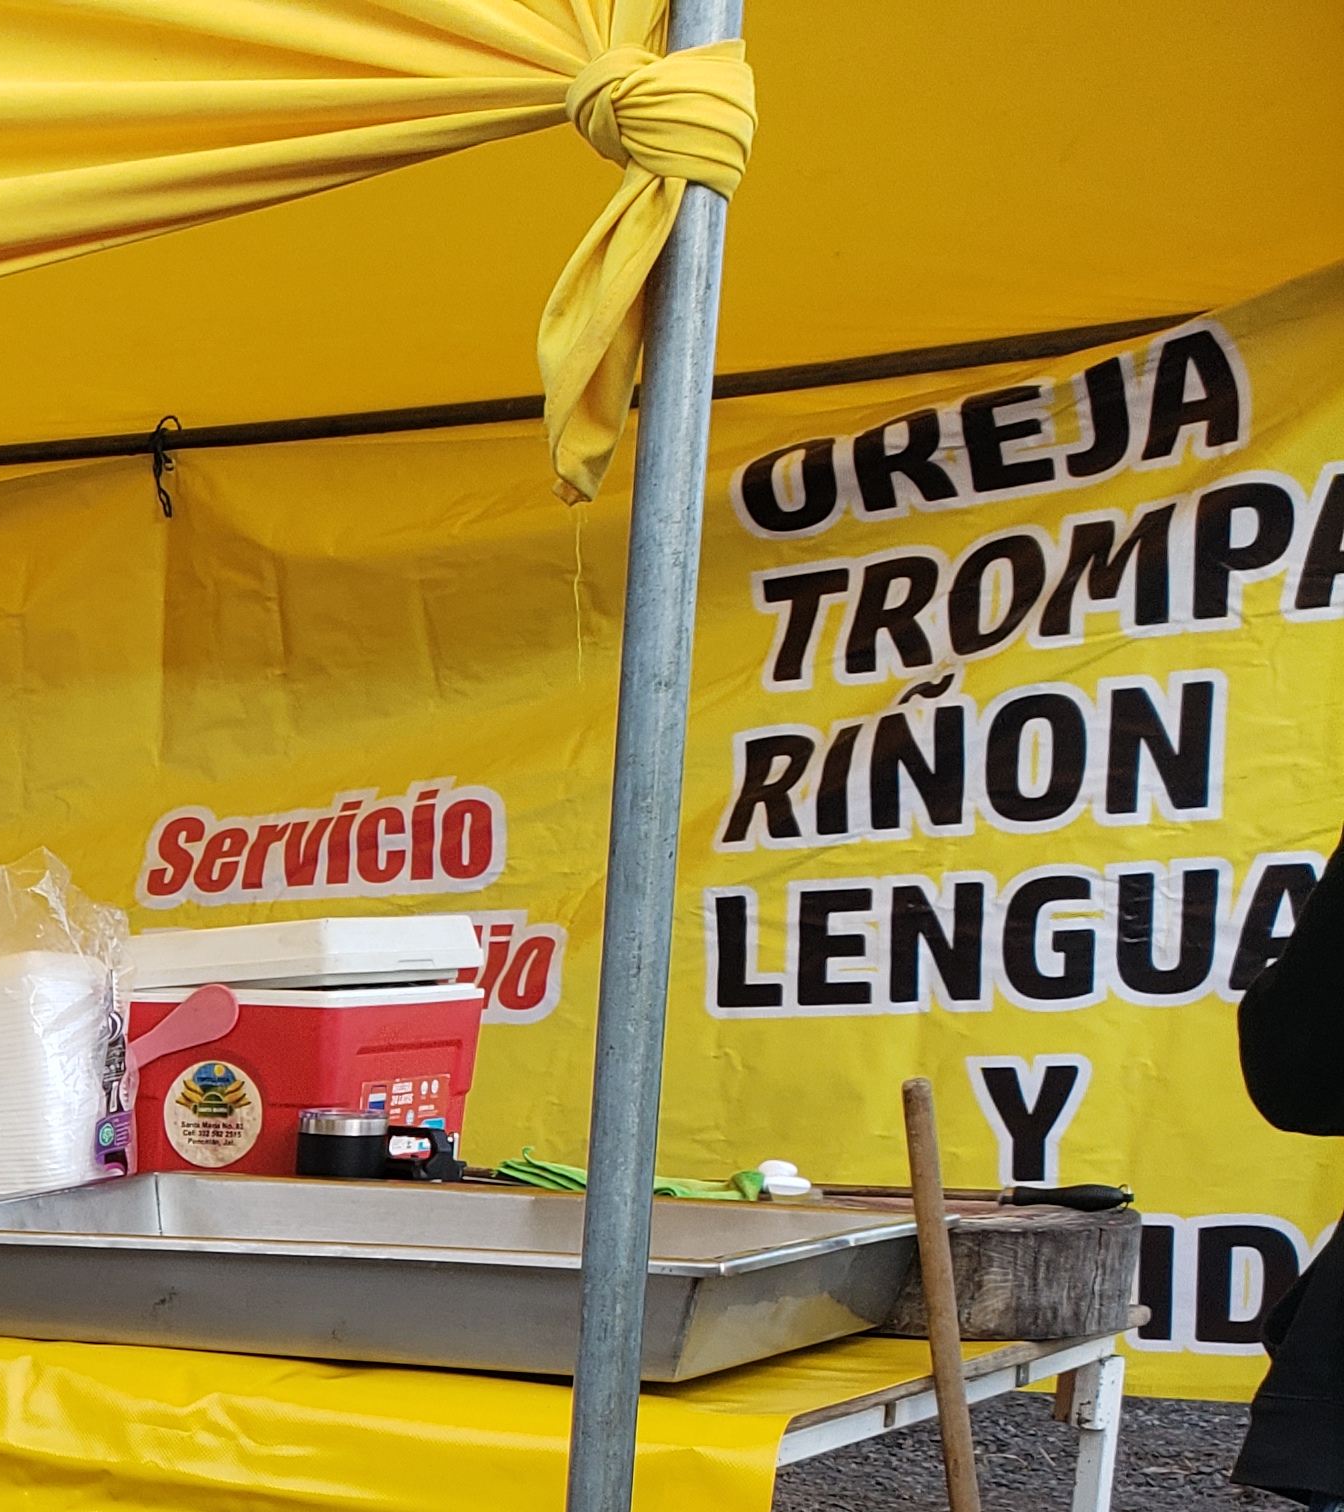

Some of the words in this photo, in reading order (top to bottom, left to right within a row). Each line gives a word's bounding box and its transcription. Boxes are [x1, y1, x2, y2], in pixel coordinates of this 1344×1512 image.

[740, 330, 1240, 533] OREJA
[721, 674, 1214, 843] RIÑON
[146, 788, 494, 897] Servicio
[714, 863, 1324, 1008] LENGUA
[981, 1064, 1079, 1182] Y
